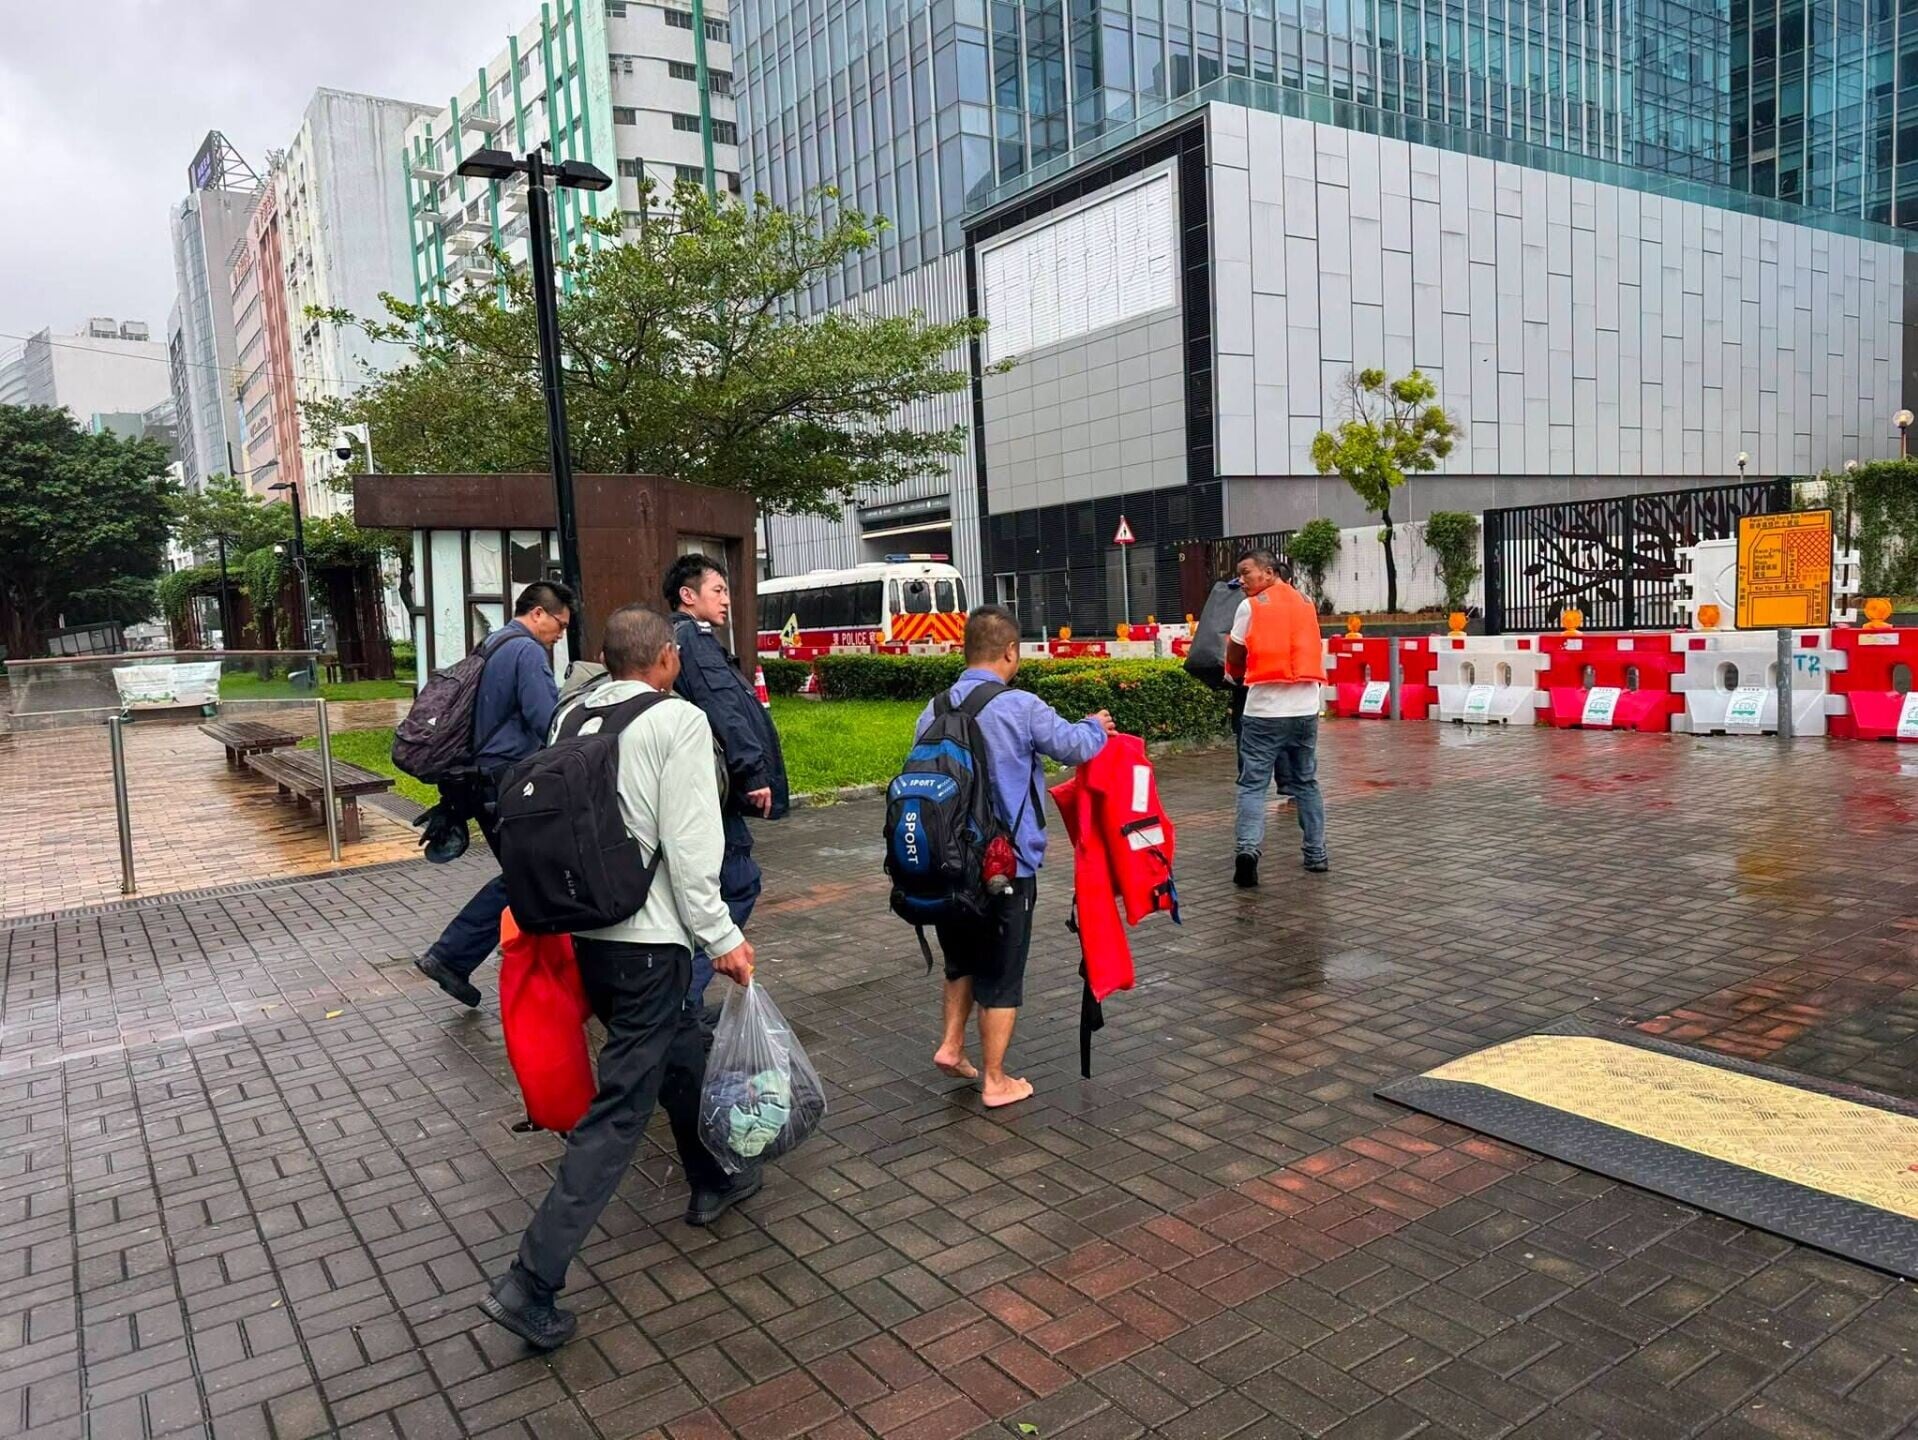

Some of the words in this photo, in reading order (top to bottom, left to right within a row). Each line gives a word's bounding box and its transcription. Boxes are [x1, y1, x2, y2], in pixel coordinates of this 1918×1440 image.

[841, 632, 867, 646] POLICE
[1793, 654, 1820, 678] T2
[909, 779, 936, 787] SPORT
[904, 812, 919, 865] SPORT
